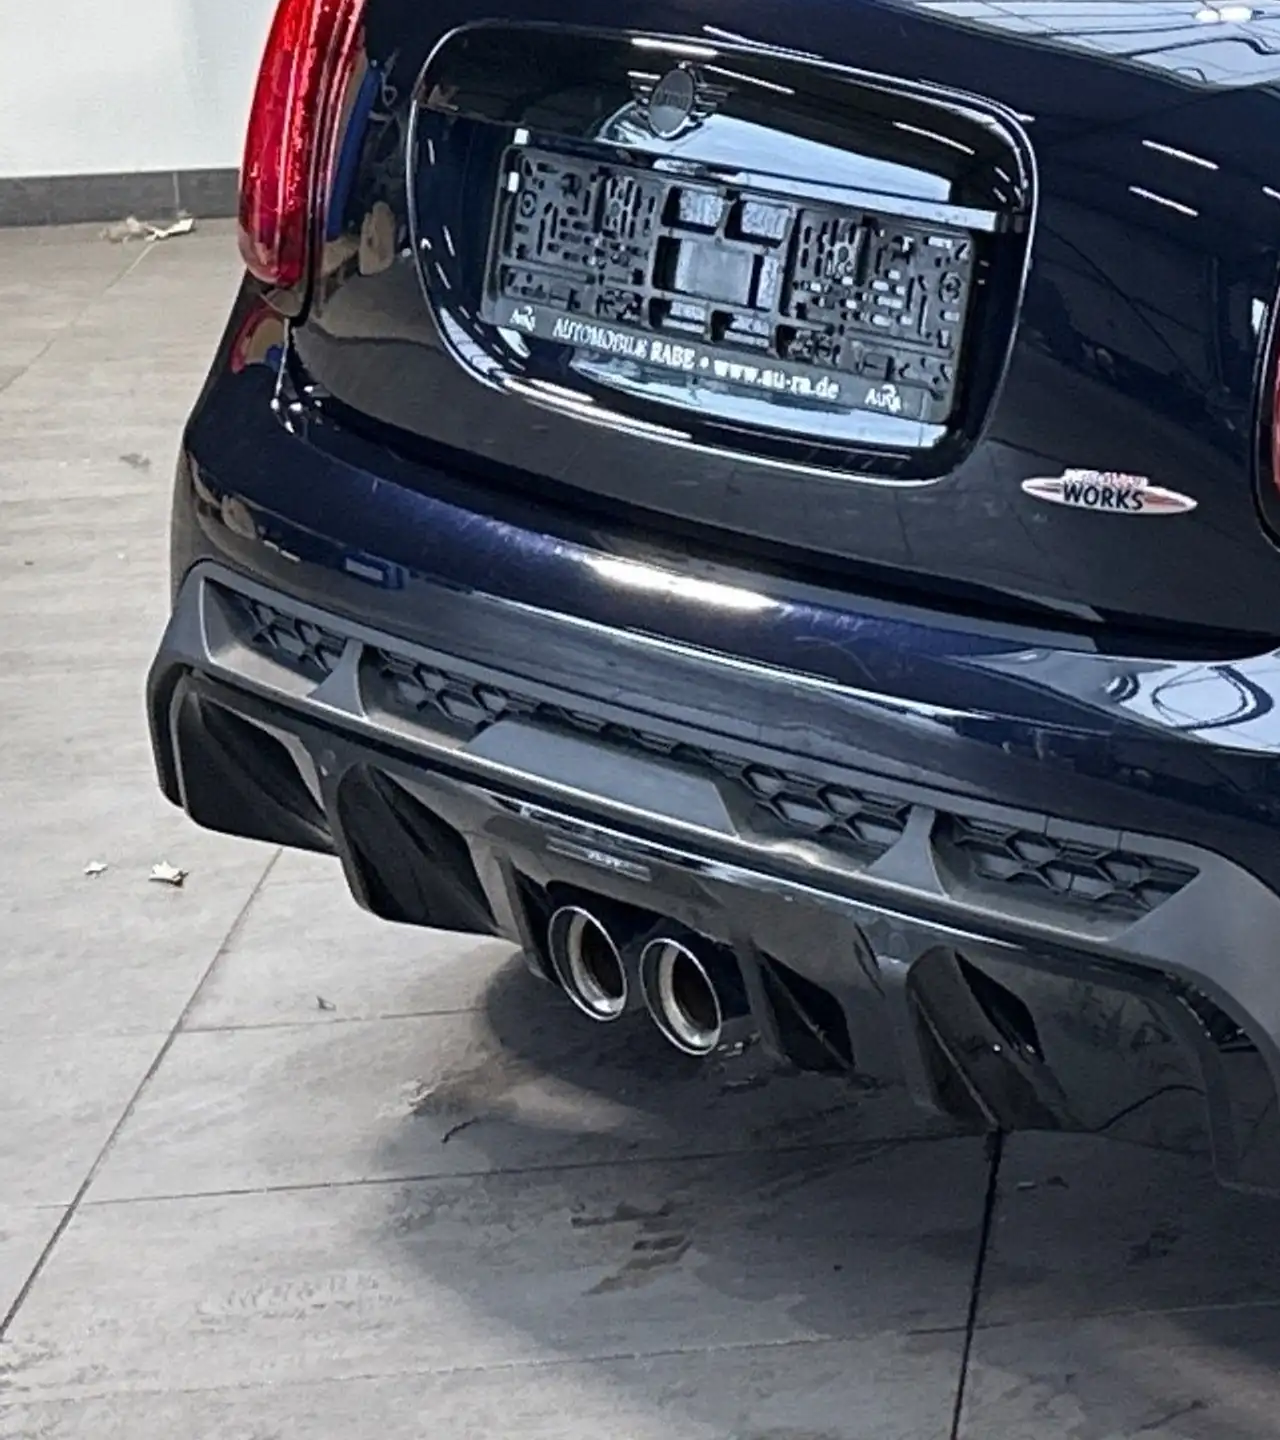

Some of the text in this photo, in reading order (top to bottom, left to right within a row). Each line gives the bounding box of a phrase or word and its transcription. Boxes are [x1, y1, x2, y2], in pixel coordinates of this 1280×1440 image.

[553, 318, 841, 399] AUTOMOBILE RABE www.au-ra.de
[1064, 483, 1145, 510] WORKS
